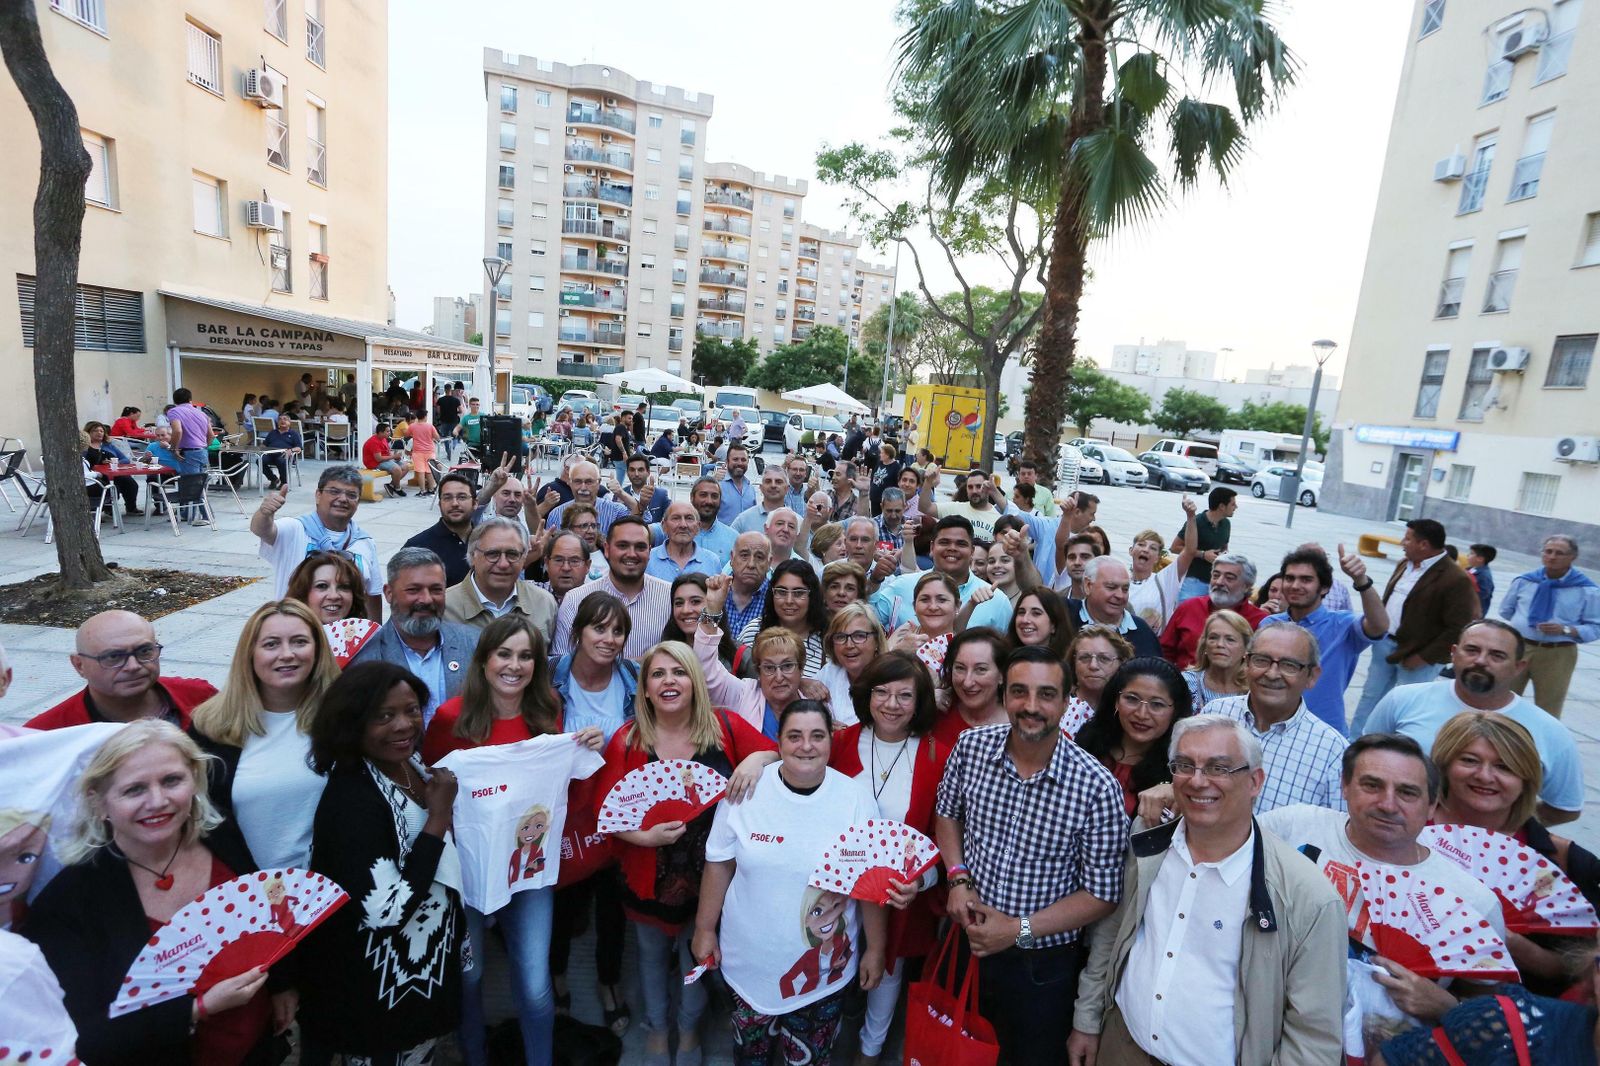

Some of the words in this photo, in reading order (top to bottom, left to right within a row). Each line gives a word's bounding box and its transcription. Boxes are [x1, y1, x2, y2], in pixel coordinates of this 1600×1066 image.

[197, 323, 228, 335] BAR
[236, 326, 255, 337] LA
[260, 328, 335, 343] CAMPANA
[209, 336, 275, 348] DESAYUNOS
[290, 342, 323, 351] TAPAS
[384, 349, 412, 357] DESAYUNOS
[427, 350, 441, 360] BAR
[443, 352, 451, 361] LA
[471, 787, 494, 799] PSOE
[618, 791, 645, 803] Mamen
[750, 832, 770, 843] PSOE
[1435, 837, 1472, 863] Mamen
[1415, 892, 1441, 930] Mamen
[154, 934, 202, 962] Mamen
